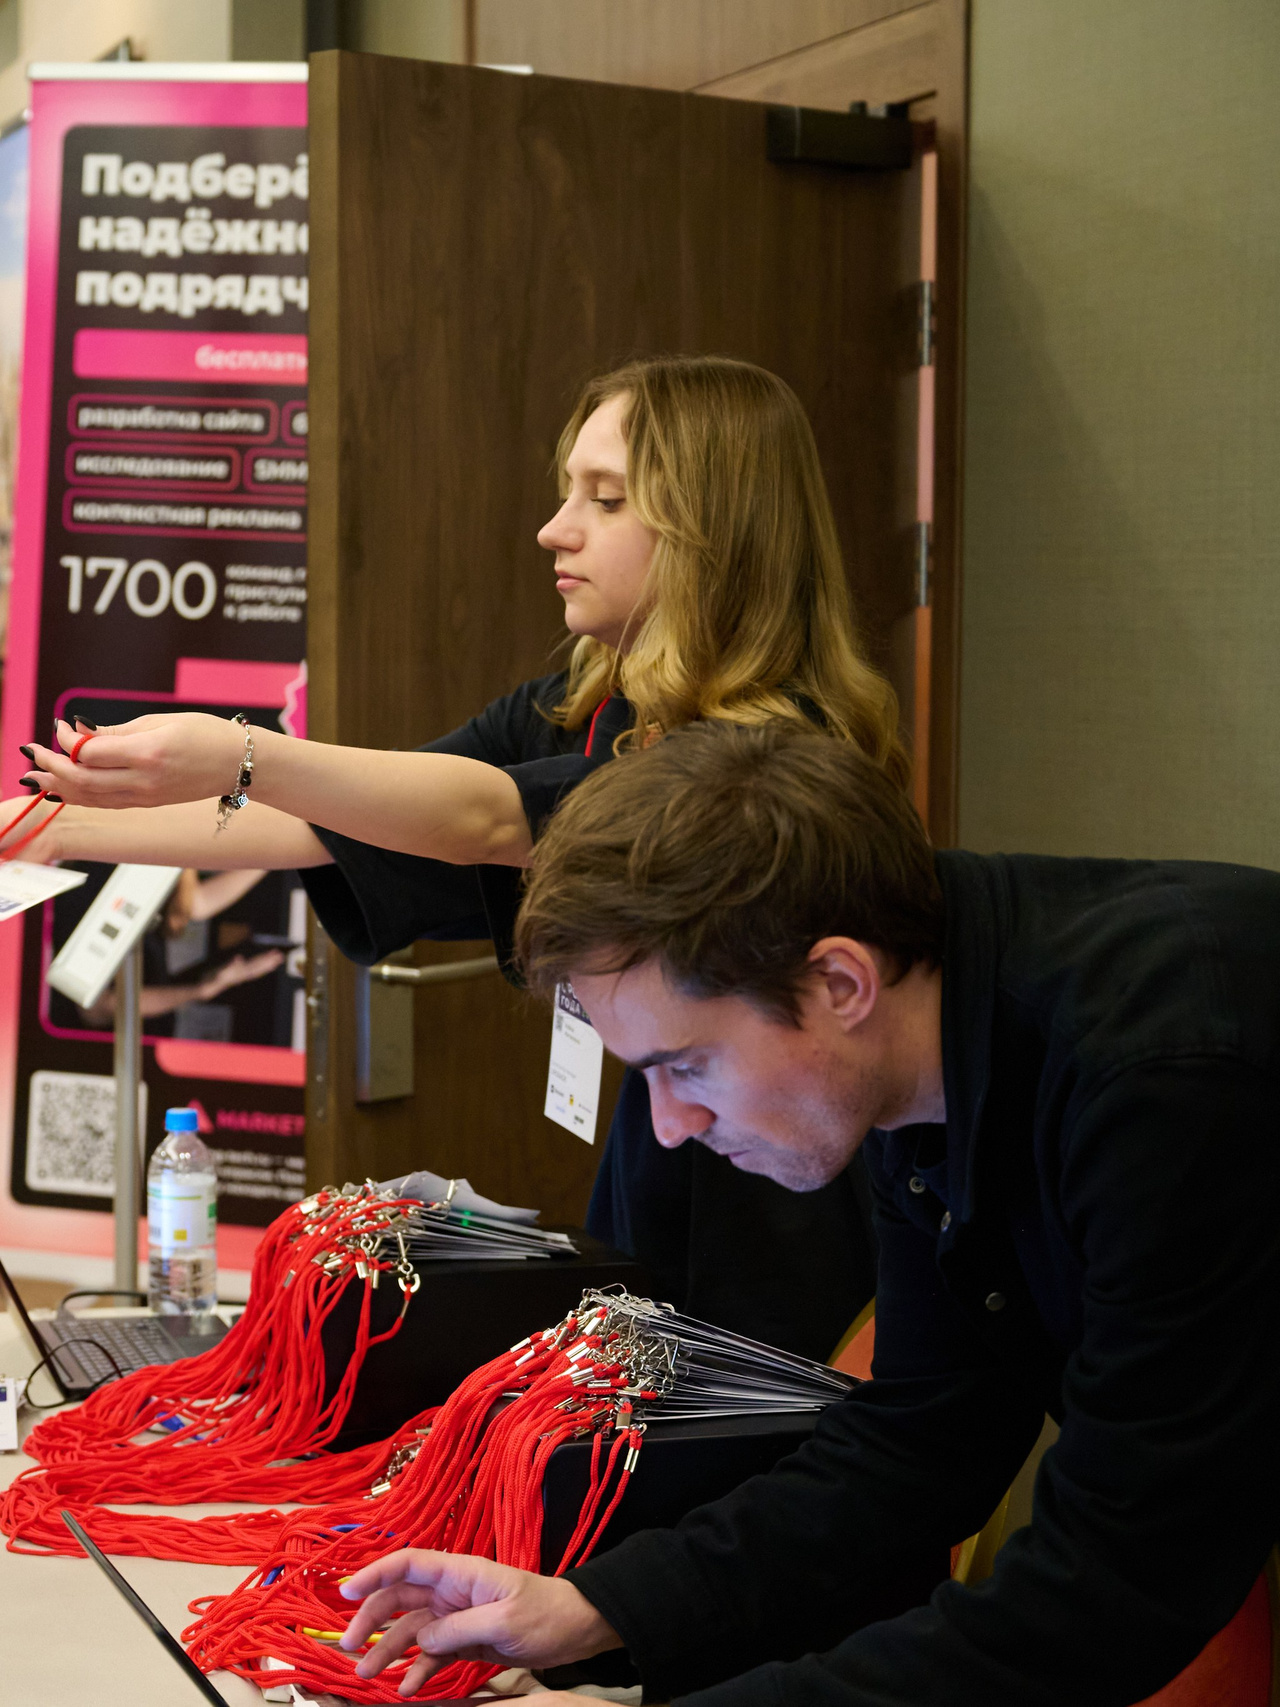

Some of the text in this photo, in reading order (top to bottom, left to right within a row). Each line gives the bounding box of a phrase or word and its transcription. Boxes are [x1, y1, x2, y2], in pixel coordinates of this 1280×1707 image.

[78, 206, 308, 257] надёжн
[77, 406, 265, 432] разработка сайта
[75, 455, 229, 480] исследование
[73, 502, 302, 530] контекстная реклама
[60, 555, 217, 620] 1700
